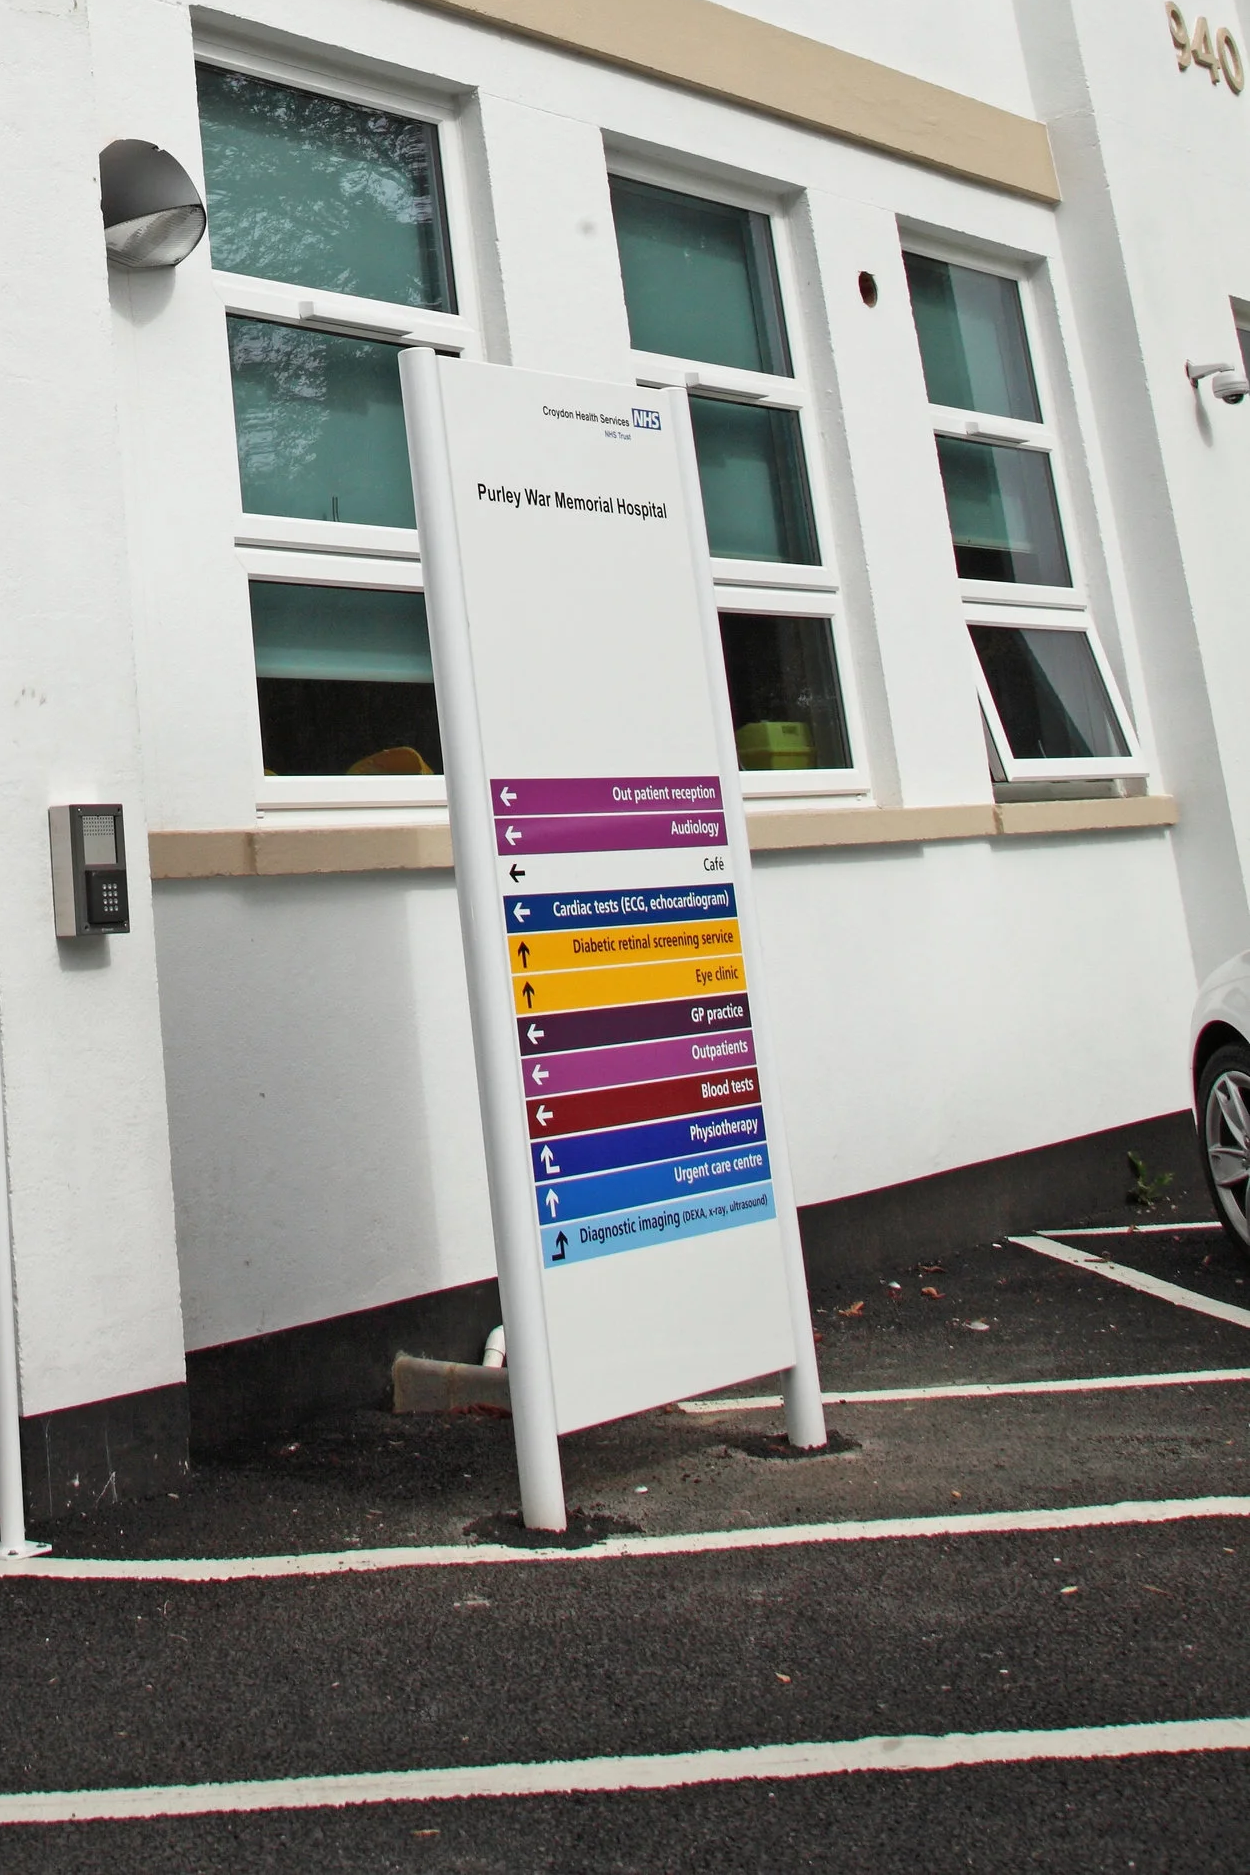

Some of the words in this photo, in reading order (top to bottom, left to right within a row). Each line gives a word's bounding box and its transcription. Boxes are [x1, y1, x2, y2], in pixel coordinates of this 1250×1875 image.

[1164, 1, 1245, 96] 940
[543, 406, 574, 420] Croydon
[575, 411, 598, 423] Health
[600, 414, 630, 427] Services
[633, 410, 660, 429] NHS
[604, 430, 617, 439] NHS
[617, 431, 631, 440] Trust
[477, 483, 521, 508] Purley
[524, 488, 551, 507] War
[554, 491, 614, 514] Memorial
[616, 498, 667, 521] Hospital
[612, 786, 632, 801] Out
[634, 785, 669, 804] patient
[671, 785, 716, 803] reception
[670, 820, 719, 837] Audiology
[703, 856, 725, 872] Café
[553, 900, 592, 917] Cardiac
[594, 899, 619, 914] tests
[621, 895, 648, 915] (ECG,
[650, 890, 729, 910] echocardiogram)
[573, 937, 616, 954] Diabetic
[618, 934, 650, 950] retinal
[653, 931, 699, 949] screening
[701, 930, 733, 944] service
[695, 968, 713, 983] Eye
[715, 965, 738, 981] clinic
[690, 1007, 704, 1023] GP
[706, 1004, 743, 1024] practice
[691, 1040, 748, 1061] Outpatients
[701, 1080, 729, 1099] Blood
[730, 1077, 754, 1093] tests
[689, 1117, 758, 1143] Physiotherapy
[674, 1161, 710, 1184] Urgent
[711, 1159, 731, 1175] care
[733, 1153, 763, 1170] centre
[579, 1218, 636, 1245] Diagnostic
[638, 1210, 681, 1233] imaging
[682, 1206, 708, 1224] (DEXA,
[708, 1202, 728, 1219] x-ray,
[730, 1194, 768, 1213] ultrasound)
